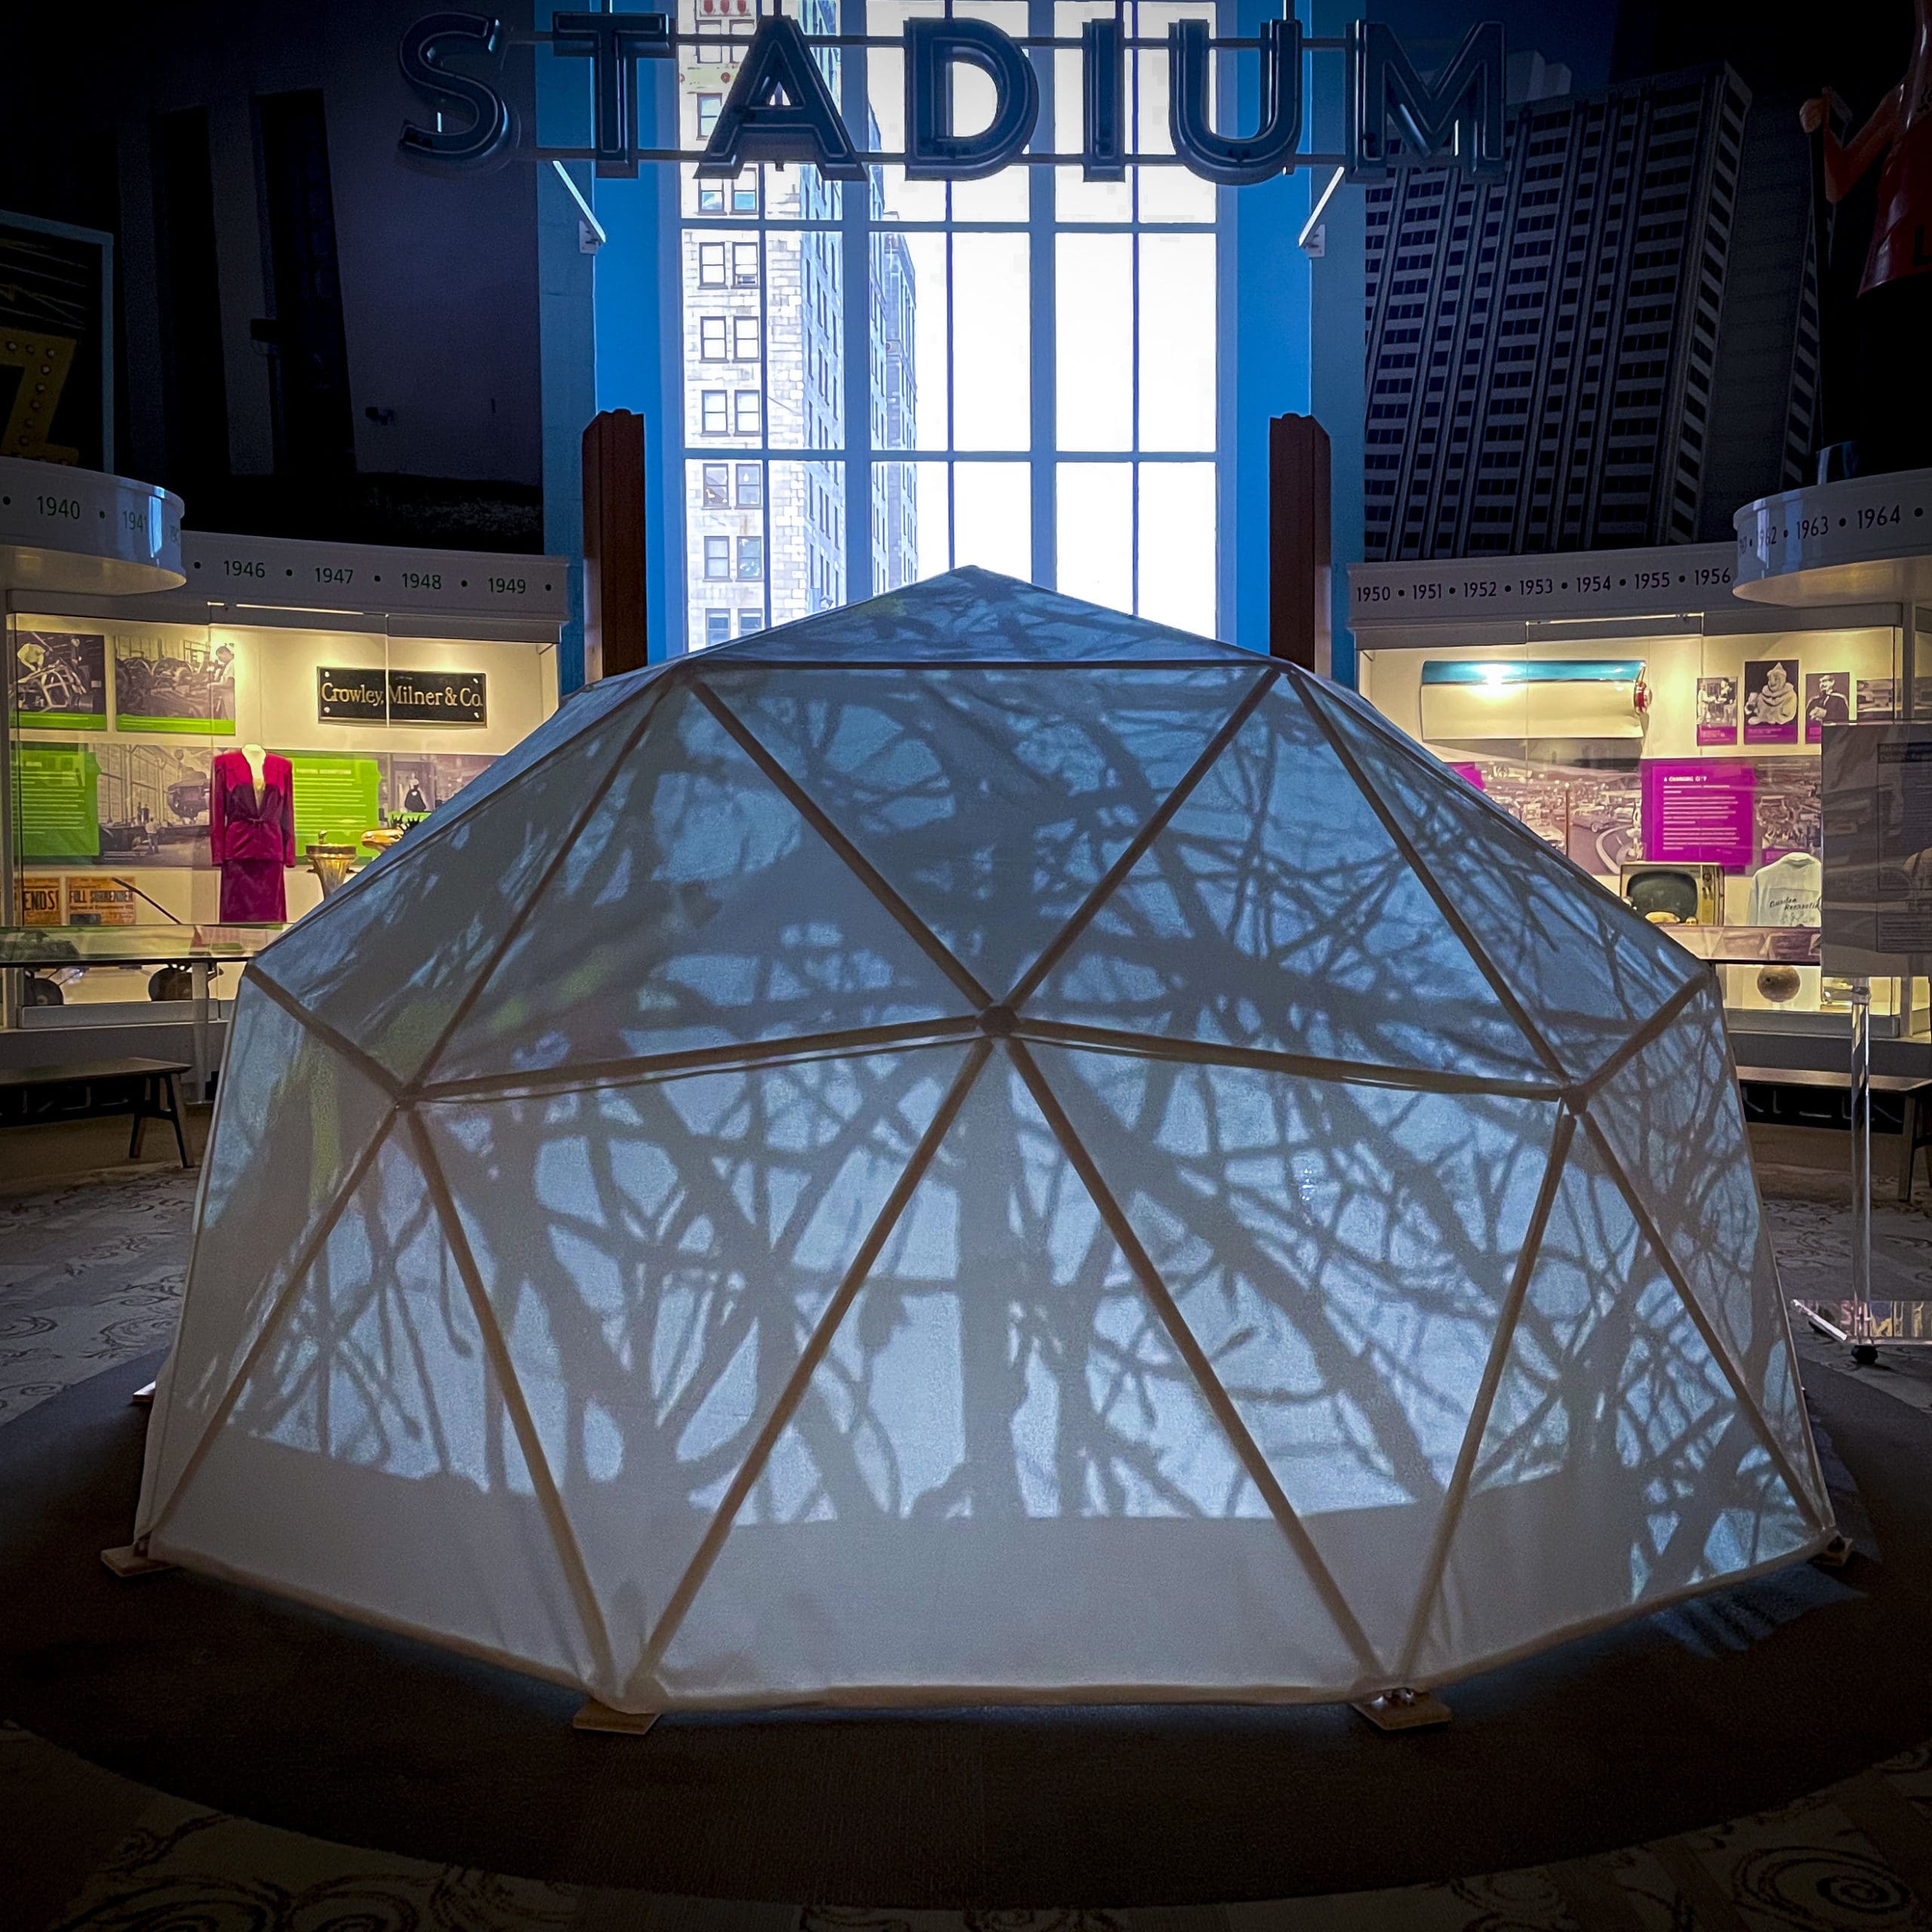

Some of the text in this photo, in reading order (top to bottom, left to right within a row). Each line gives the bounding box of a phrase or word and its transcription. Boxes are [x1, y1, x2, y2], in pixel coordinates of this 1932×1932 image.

[398, 11, 1506, 180] STADIUM
[37, 496, 80, 520] 1940
[1796, 515, 1829, 540] 1963
[1857, 504, 1900, 529] 1964
[223, 560, 526, 595] 1946 1947 1948 1949
[1357, 567, 1731, 602] 1950 1951 1952 1953 1954 1955 1956
[321, 682, 384, 706] Crowley,
[387, 685, 443, 706] Milner
[445, 686, 458, 706] &
[69, 890, 88, 903] FULL
